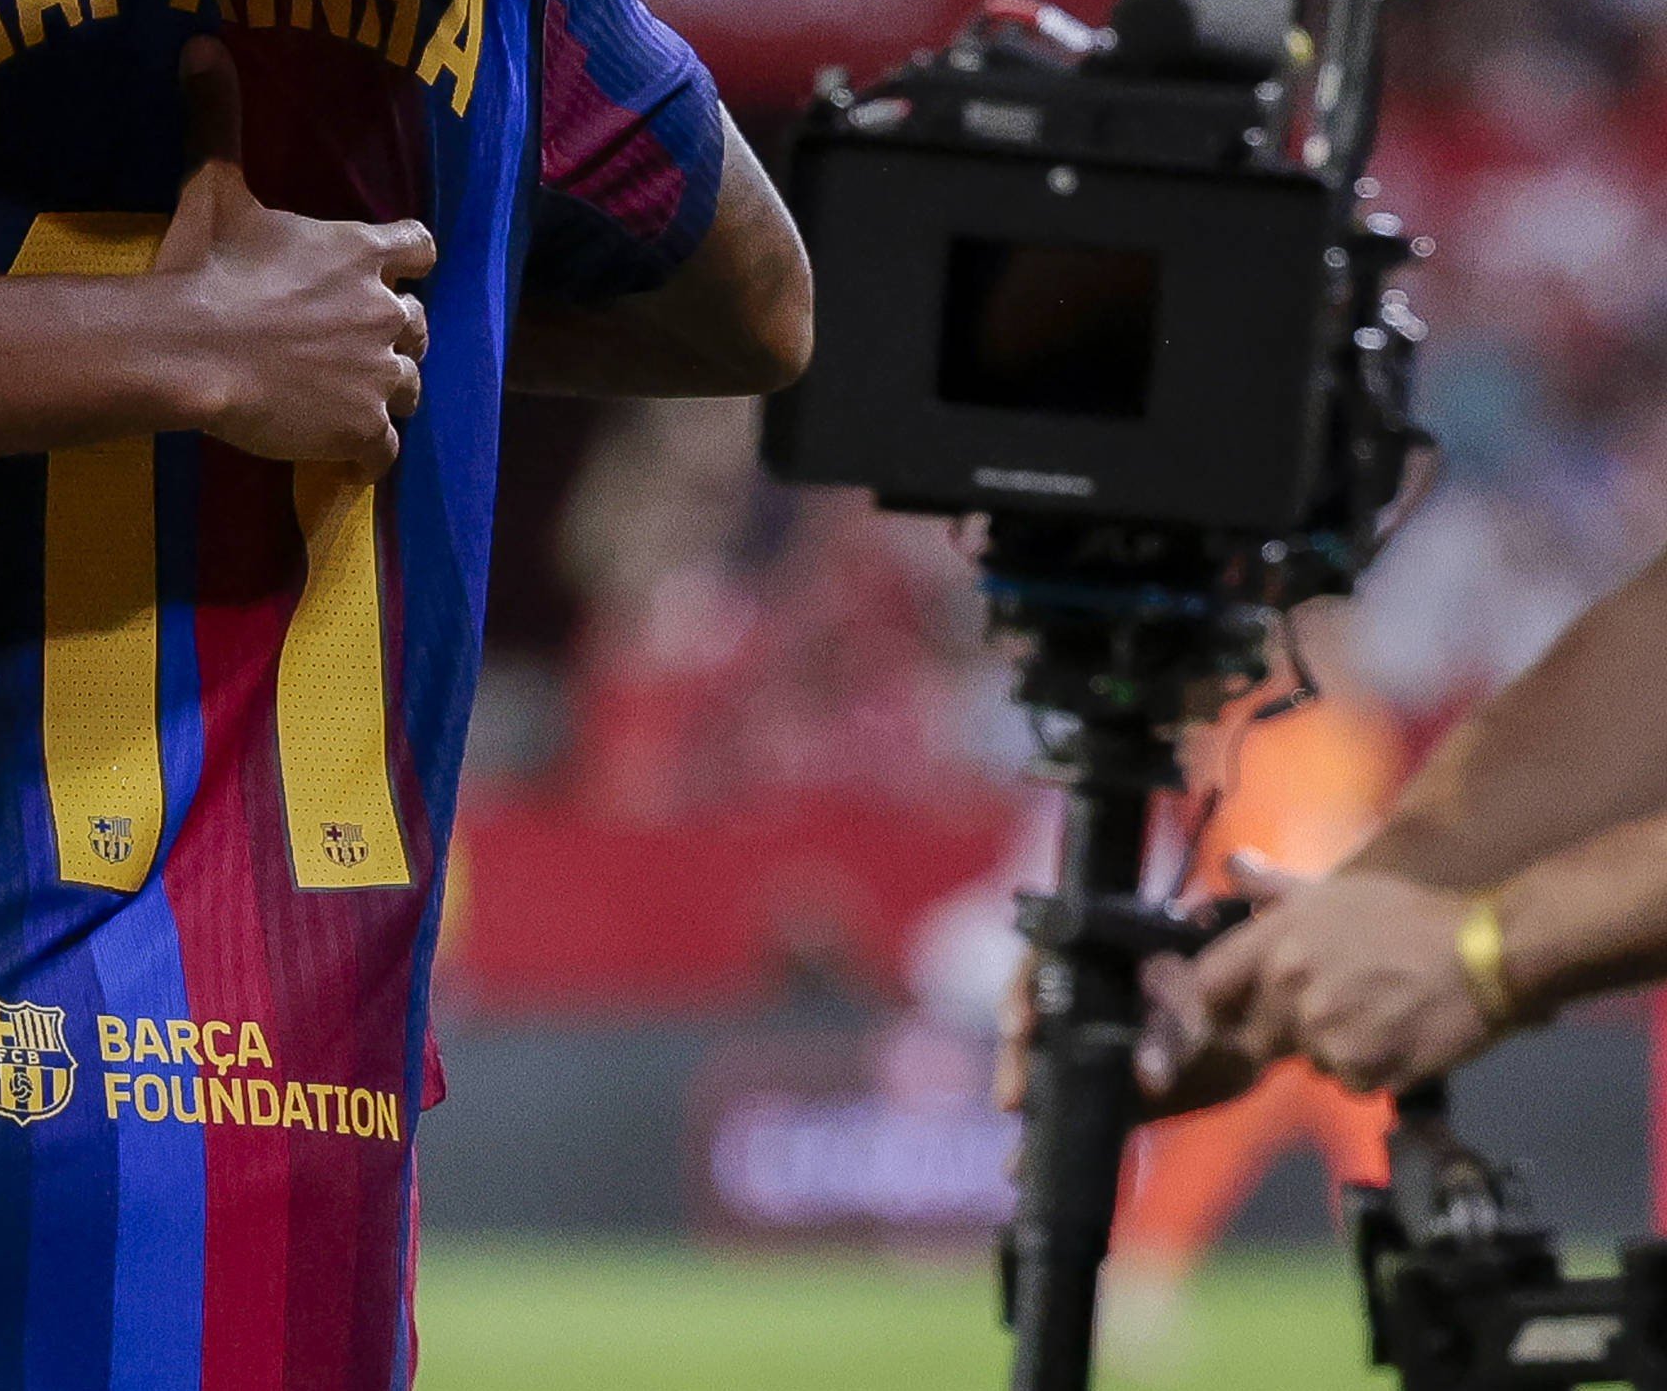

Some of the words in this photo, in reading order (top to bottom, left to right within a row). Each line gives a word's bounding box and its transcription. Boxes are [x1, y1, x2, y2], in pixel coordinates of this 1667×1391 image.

[5, 211, 413, 892] 11
[96, 1015, 274, 1076] BARÇA
[104, 1072, 400, 1142] FOUNDATION
